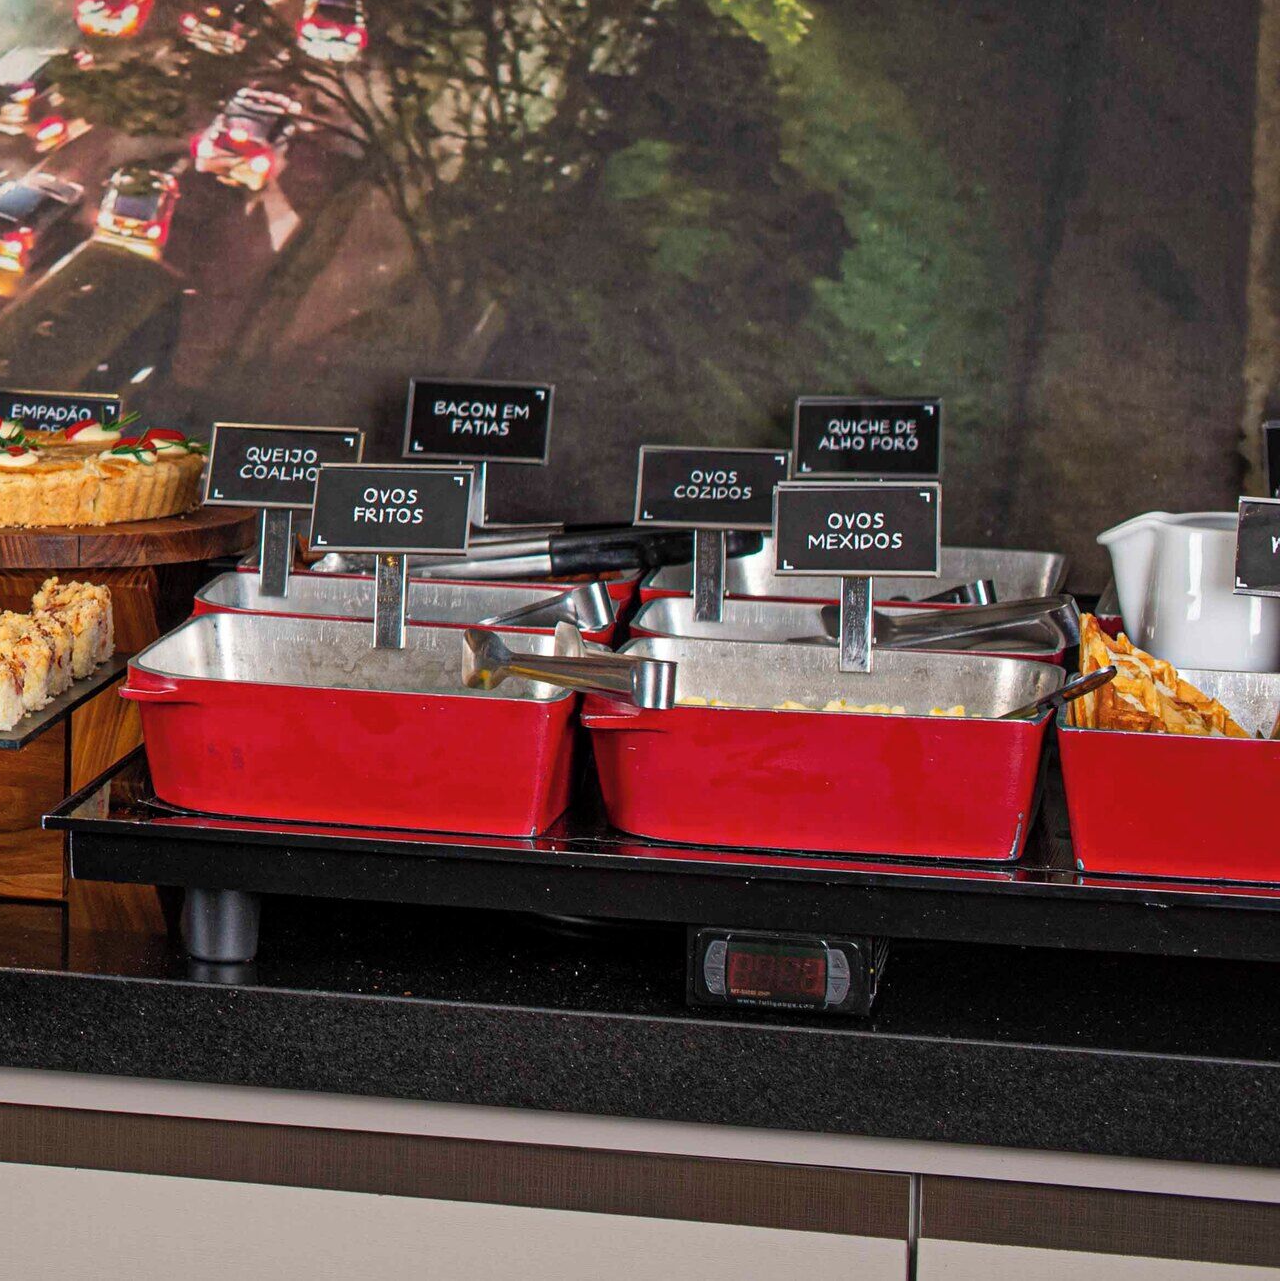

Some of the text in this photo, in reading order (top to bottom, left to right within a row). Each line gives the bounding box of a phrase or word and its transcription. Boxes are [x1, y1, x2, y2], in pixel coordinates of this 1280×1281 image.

[11, 403, 92, 421] EMPADÃO
[434, 401, 530, 420] BACON EM
[452, 419, 510, 436] FATIAS
[828, 419, 917, 436] QUICHE DE
[818, 434, 919, 451] ALHO PORÓ
[246, 446, 318, 465] QUEIJO
[239, 464, 319, 482] COALHO
[691, 470, 737, 484] OVOS
[363, 488, 418, 504] OVOS
[674, 485, 752, 500] COZIDOS
[353, 506, 424, 524] FRITOS
[828, 513, 884, 529] OVOS
[808, 533, 902, 550] MEXIDOS
